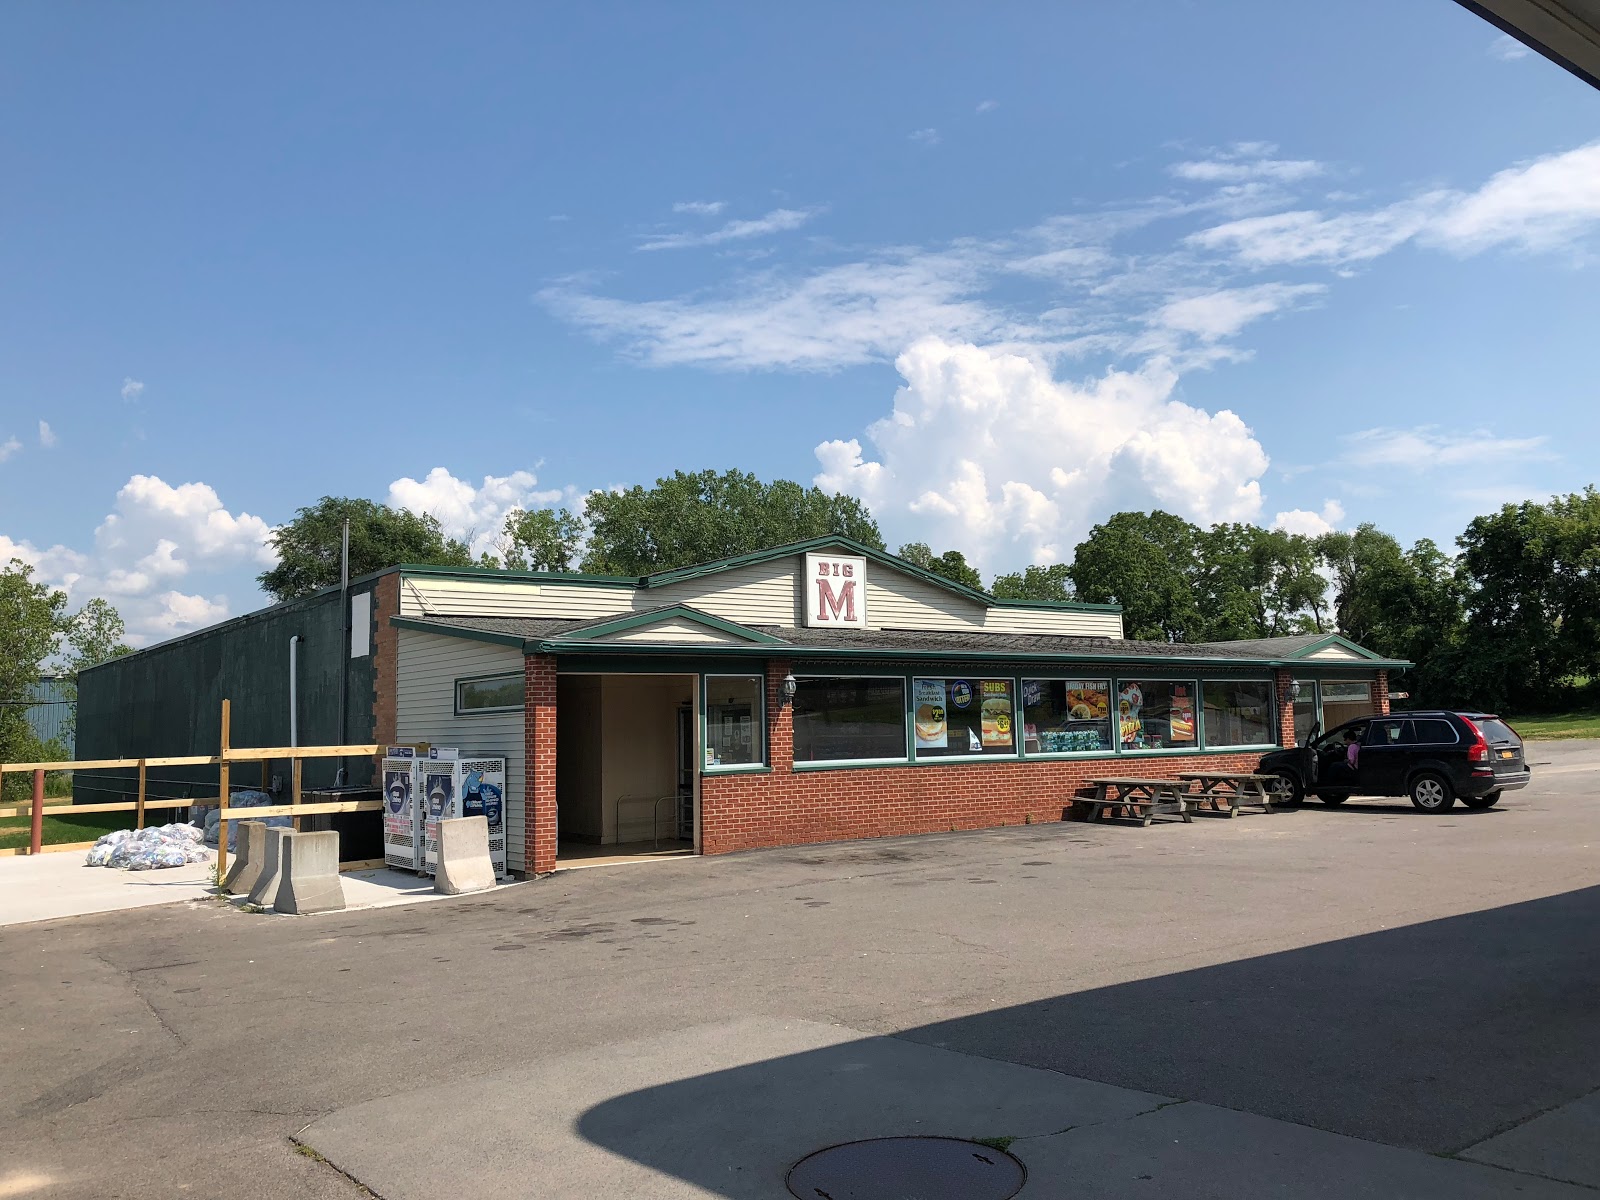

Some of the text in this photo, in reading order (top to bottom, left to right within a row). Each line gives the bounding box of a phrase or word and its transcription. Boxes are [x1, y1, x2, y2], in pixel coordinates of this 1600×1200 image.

[818, 562, 853, 577] BIG
[816, 579, 857, 621] M
[984, 682, 1006, 692] SUBS
[1023, 683, 1038, 698] Quick
[1085, 682, 1096, 690] FISH
[1027, 691, 1041, 706] Draw
[1120, 720, 1141, 737] PIZZA
